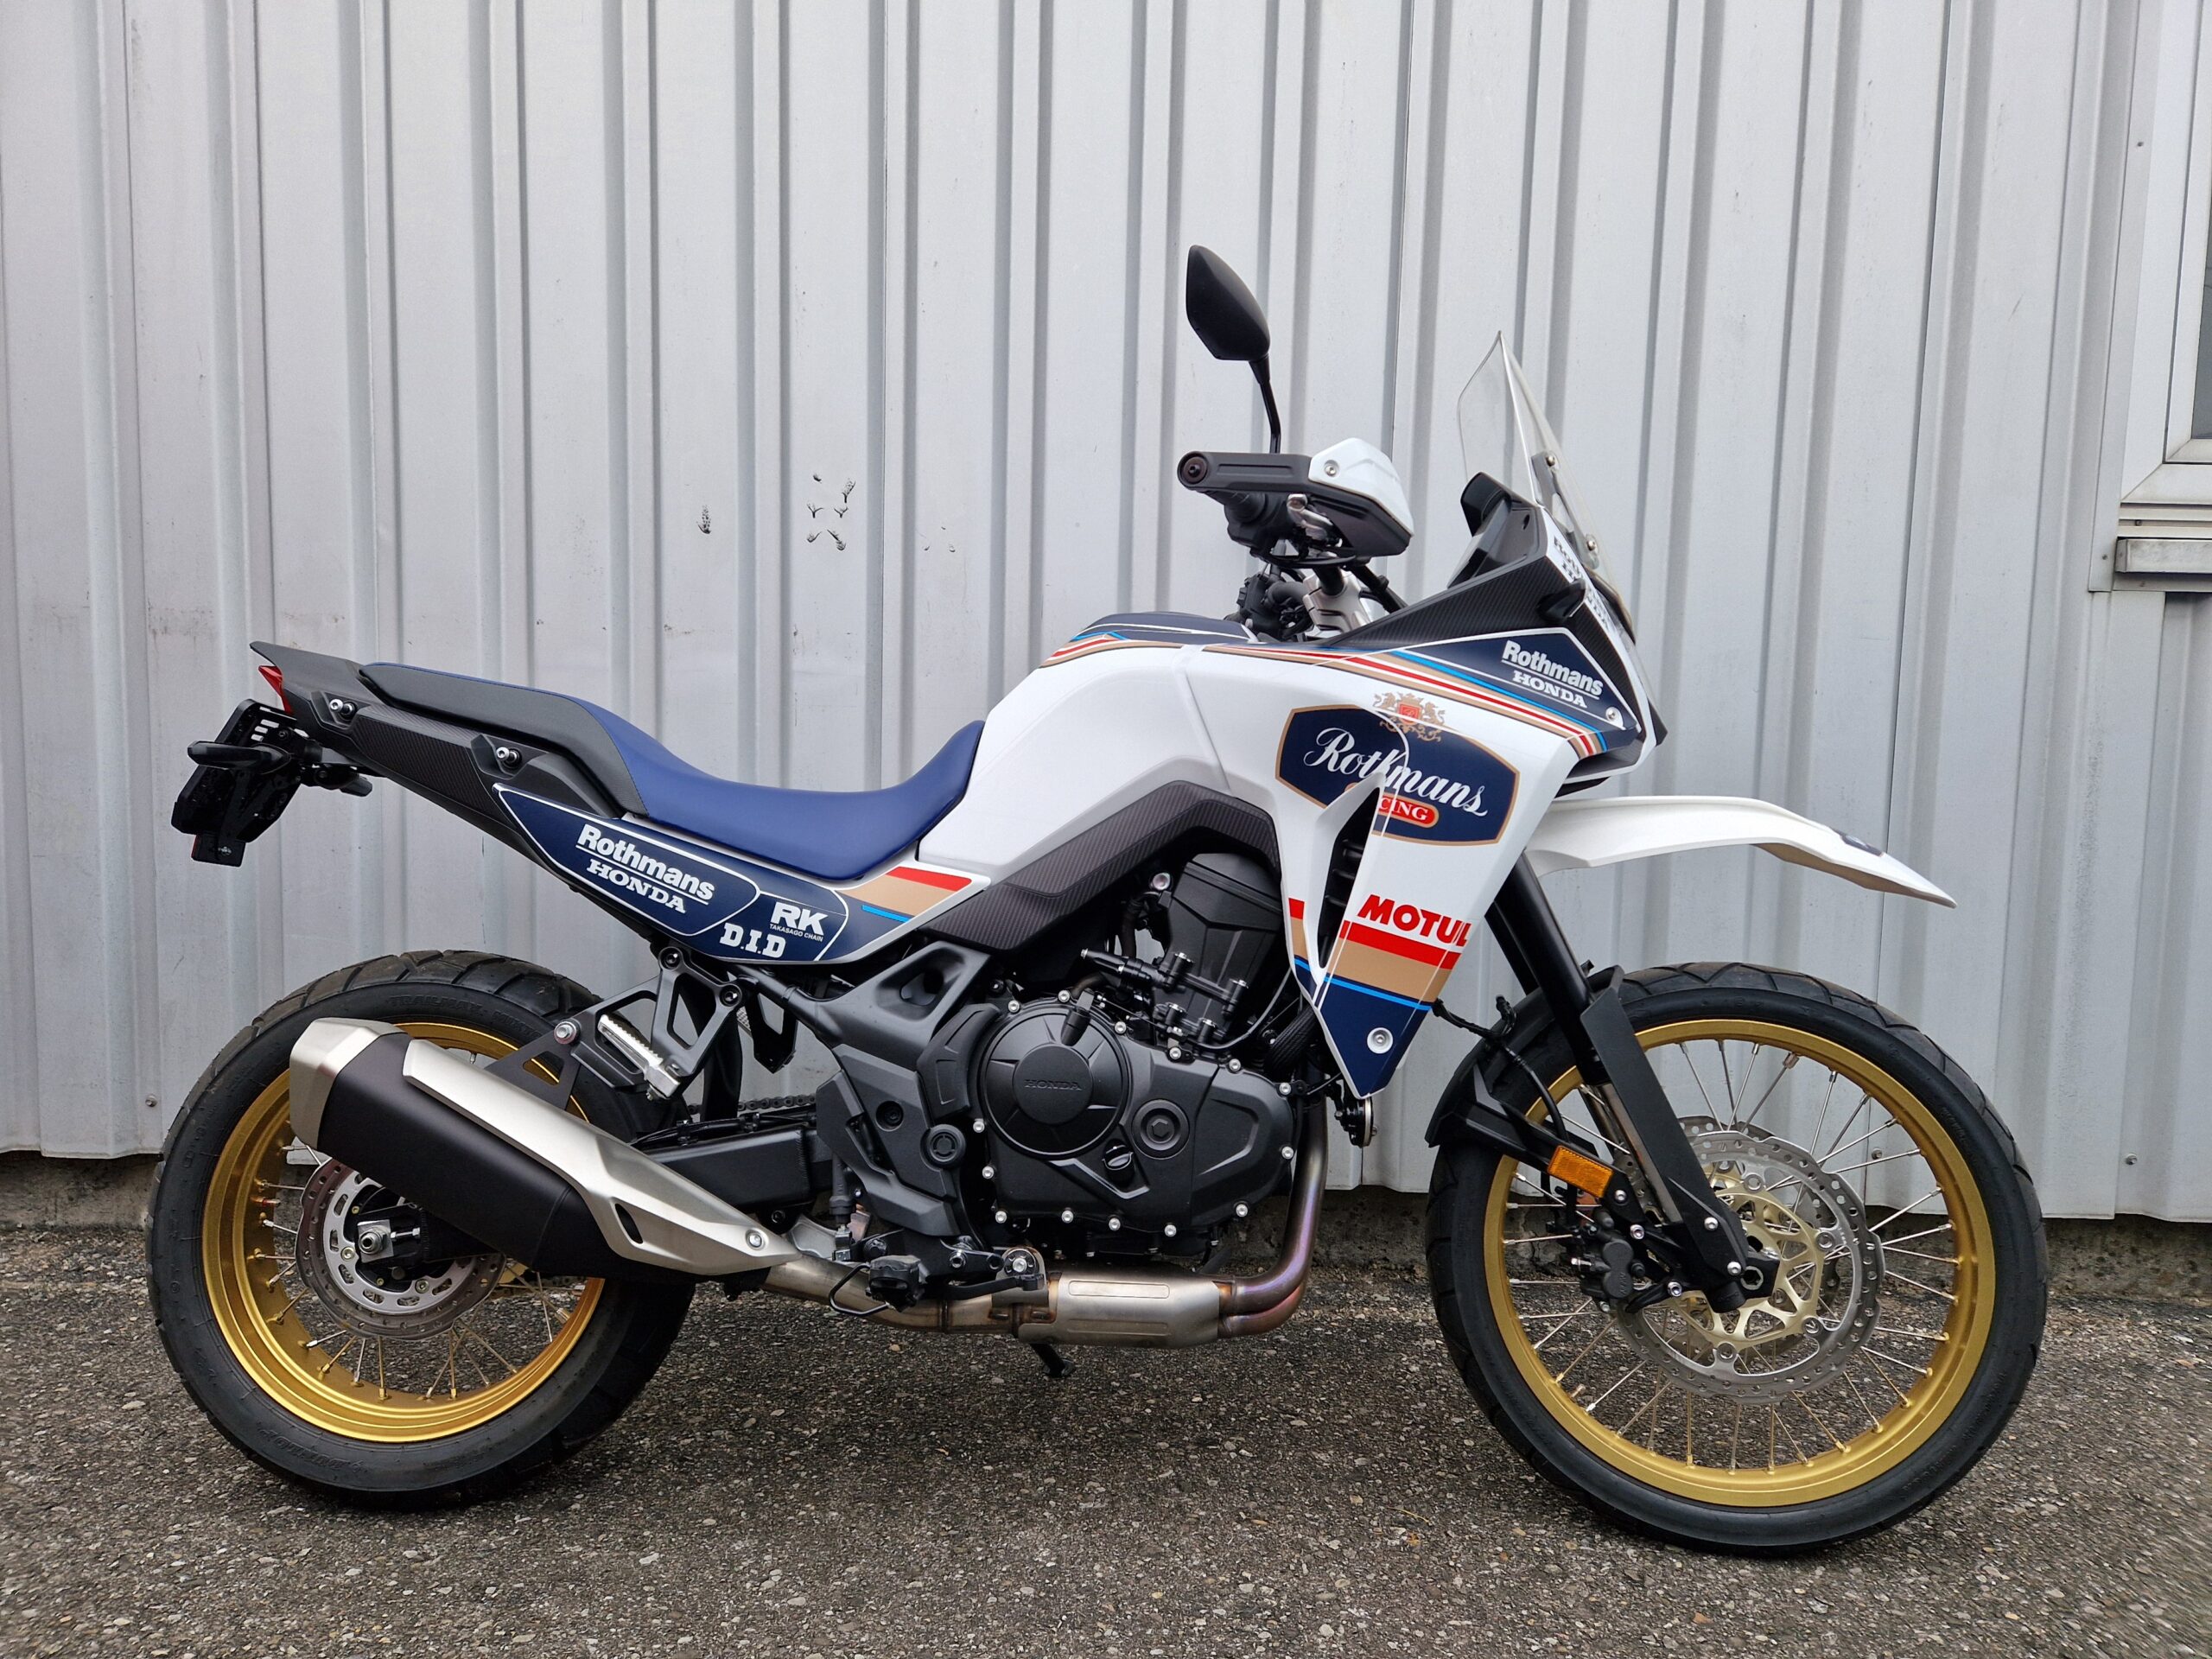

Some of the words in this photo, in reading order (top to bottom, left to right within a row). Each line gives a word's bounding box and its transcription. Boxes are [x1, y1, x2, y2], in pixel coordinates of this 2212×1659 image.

[1502, 639, 1604, 696] Rothmans
[1512, 670, 1588, 709] HONDA
[1302, 727, 1489, 817] Rothmans
[1378, 797, 1429, 821] CING
[576, 823, 715, 900] Rothmans
[586, 858, 687, 914] HONDA
[769, 901, 829, 936] RK
[769, 923, 804, 938] TAKASAGO
[804, 932, 824, 943] CHAIN
[1357, 893, 1471, 948] MOTUL
[1024, 1078, 1083, 1091] HONDA
